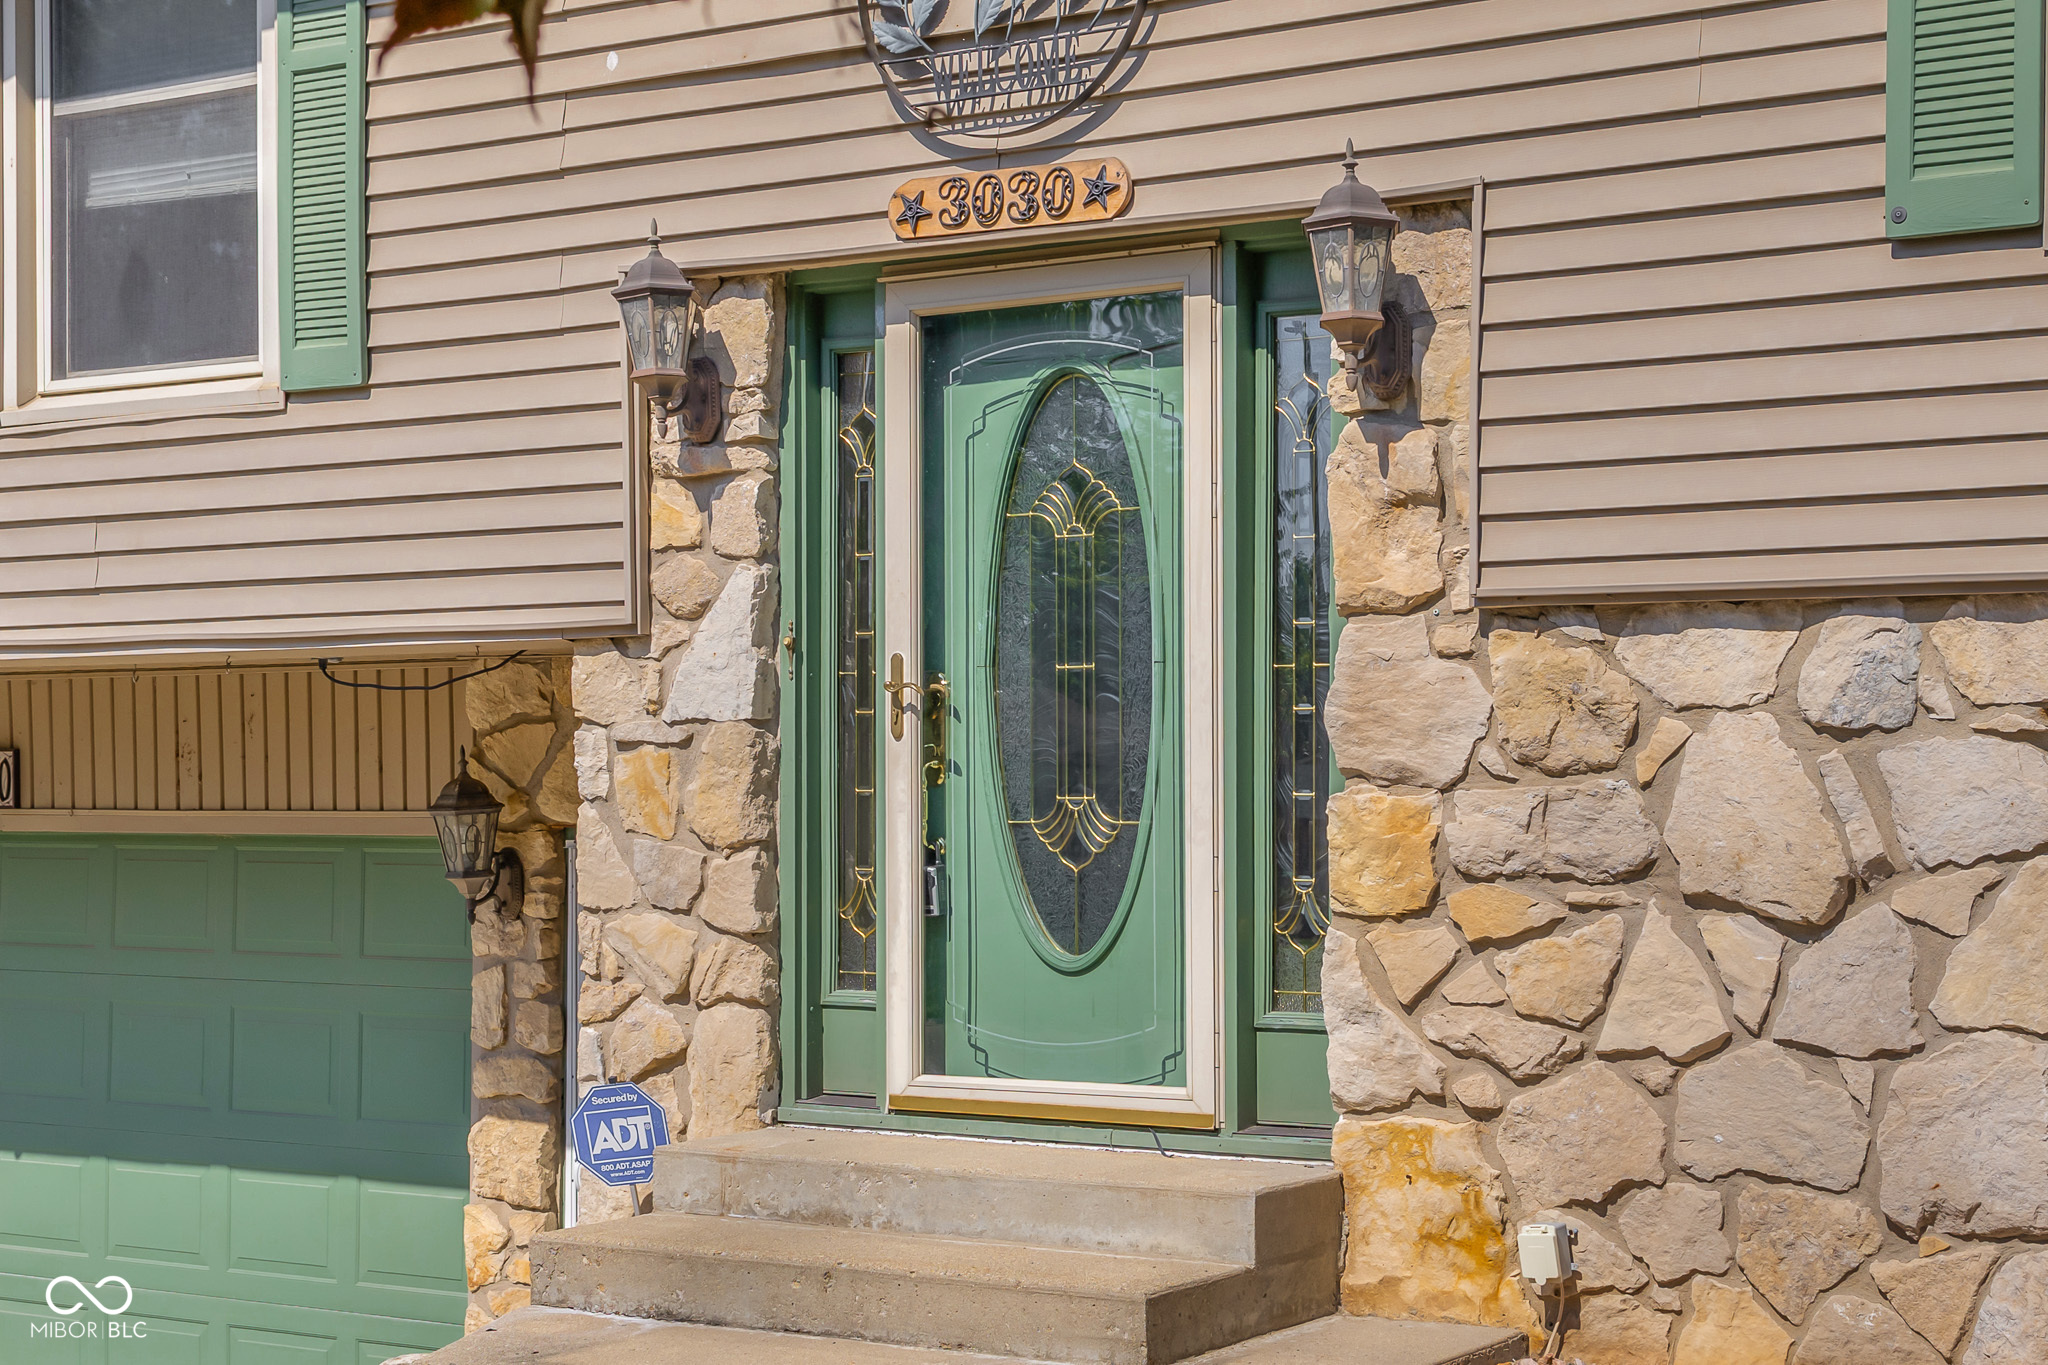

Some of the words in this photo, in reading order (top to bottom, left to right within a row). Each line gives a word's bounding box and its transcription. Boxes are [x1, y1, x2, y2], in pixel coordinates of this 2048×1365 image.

[929, 33, 1080, 102] WELCOME
[938, 166, 1075, 229] 3030
[591, 1093, 626, 1105] Secured
[627, 1093, 638, 1102] by
[592, 1115, 651, 1155] ADT
[600, 1160, 651, 1172] 800.ADT.ASAP
[610, 1169, 646, 1177] www.ADT.com
